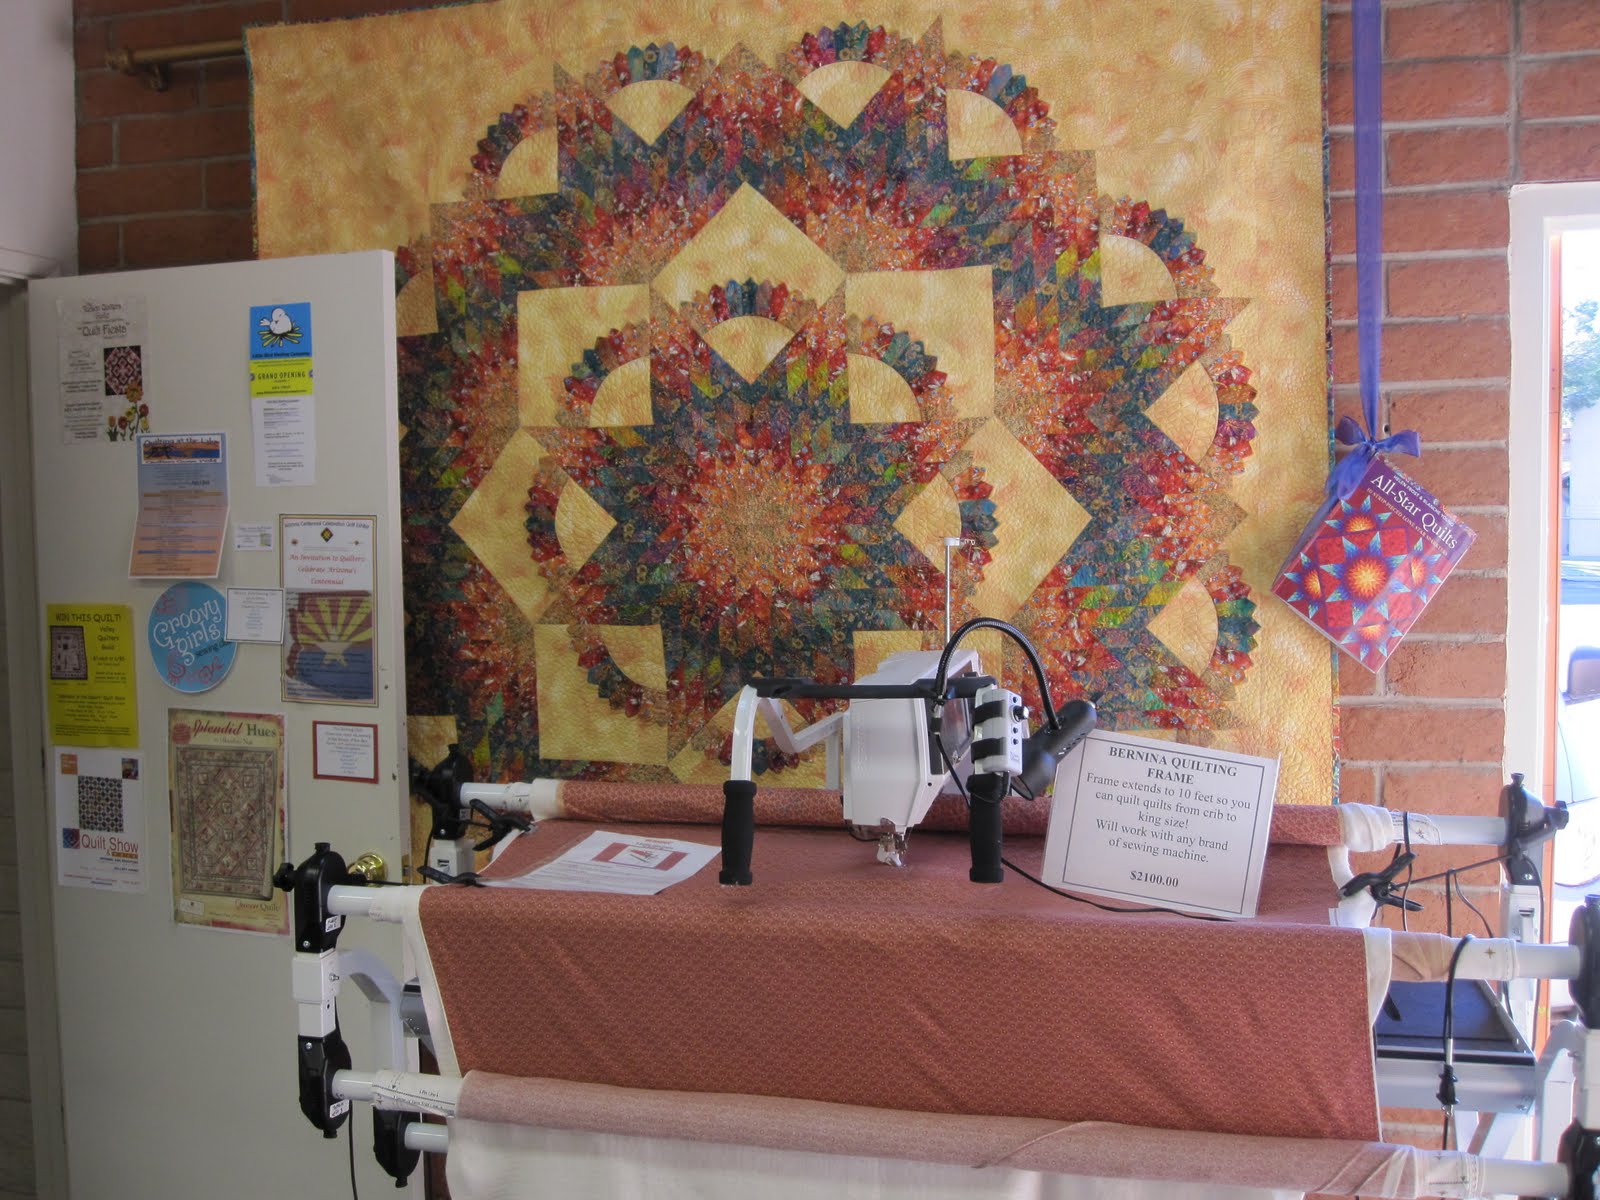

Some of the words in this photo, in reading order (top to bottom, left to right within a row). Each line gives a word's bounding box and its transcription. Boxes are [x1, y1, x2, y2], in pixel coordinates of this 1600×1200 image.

[258, 372, 278, 380] GRAND
[279, 371, 306, 379] OPENING
[1393, 475, 1408, 488] HELEN
[1406, 484, 1420, 498] FROST
[1371, 474, 1421, 516] All-Star
[1422, 513, 1458, 550] Quilts
[1402, 515, 1415, 528] LONE
[56, 613, 70, 622] WIN
[71, 613, 92, 622] THIS
[153, 599, 222, 649] Groovy
[192, 719, 244, 738] Splendid
[246, 723, 277, 737] Hues
[1109, 746, 1168, 766] BERNINA
[1171, 757, 1238, 777] QUILTING
[1147, 767, 1194, 785] FRAME
[1086, 772, 1119, 787] Frame
[1122, 779, 1162, 795] extends
[1164, 786, 1175, 797] to
[1179, 788, 1191, 799] 10
[1194, 790, 1214, 803] feet
[1216, 796, 1228, 806] so
[1231, 798, 1251, 810] you
[1095, 791, 1114, 802] can
[1116, 793, 1140, 808] quilt
[1143, 797, 1172, 812] quilts
[1175, 802, 1200, 816] from
[1203, 806, 1223, 820] crib
[1226, 811, 1237, 822] to
[1138, 811, 1161, 828] king
[1164, 816, 1189, 830] size!
[81, 833, 107, 850] Quilt
[109, 836, 139, 853] Show
[1096, 818, 1118, 832] Will
[1121, 824, 1148, 837] work
[1151, 829, 1174, 842] with
[1176, 834, 1195, 847] any
[1198, 837, 1228, 851] brand
[1108, 837, 1122, 849] of
[1122, 841, 1159, 857] sewing
[1162, 846, 1209, 864] machine.
[1130, 870, 1179, 888] $2100.00
